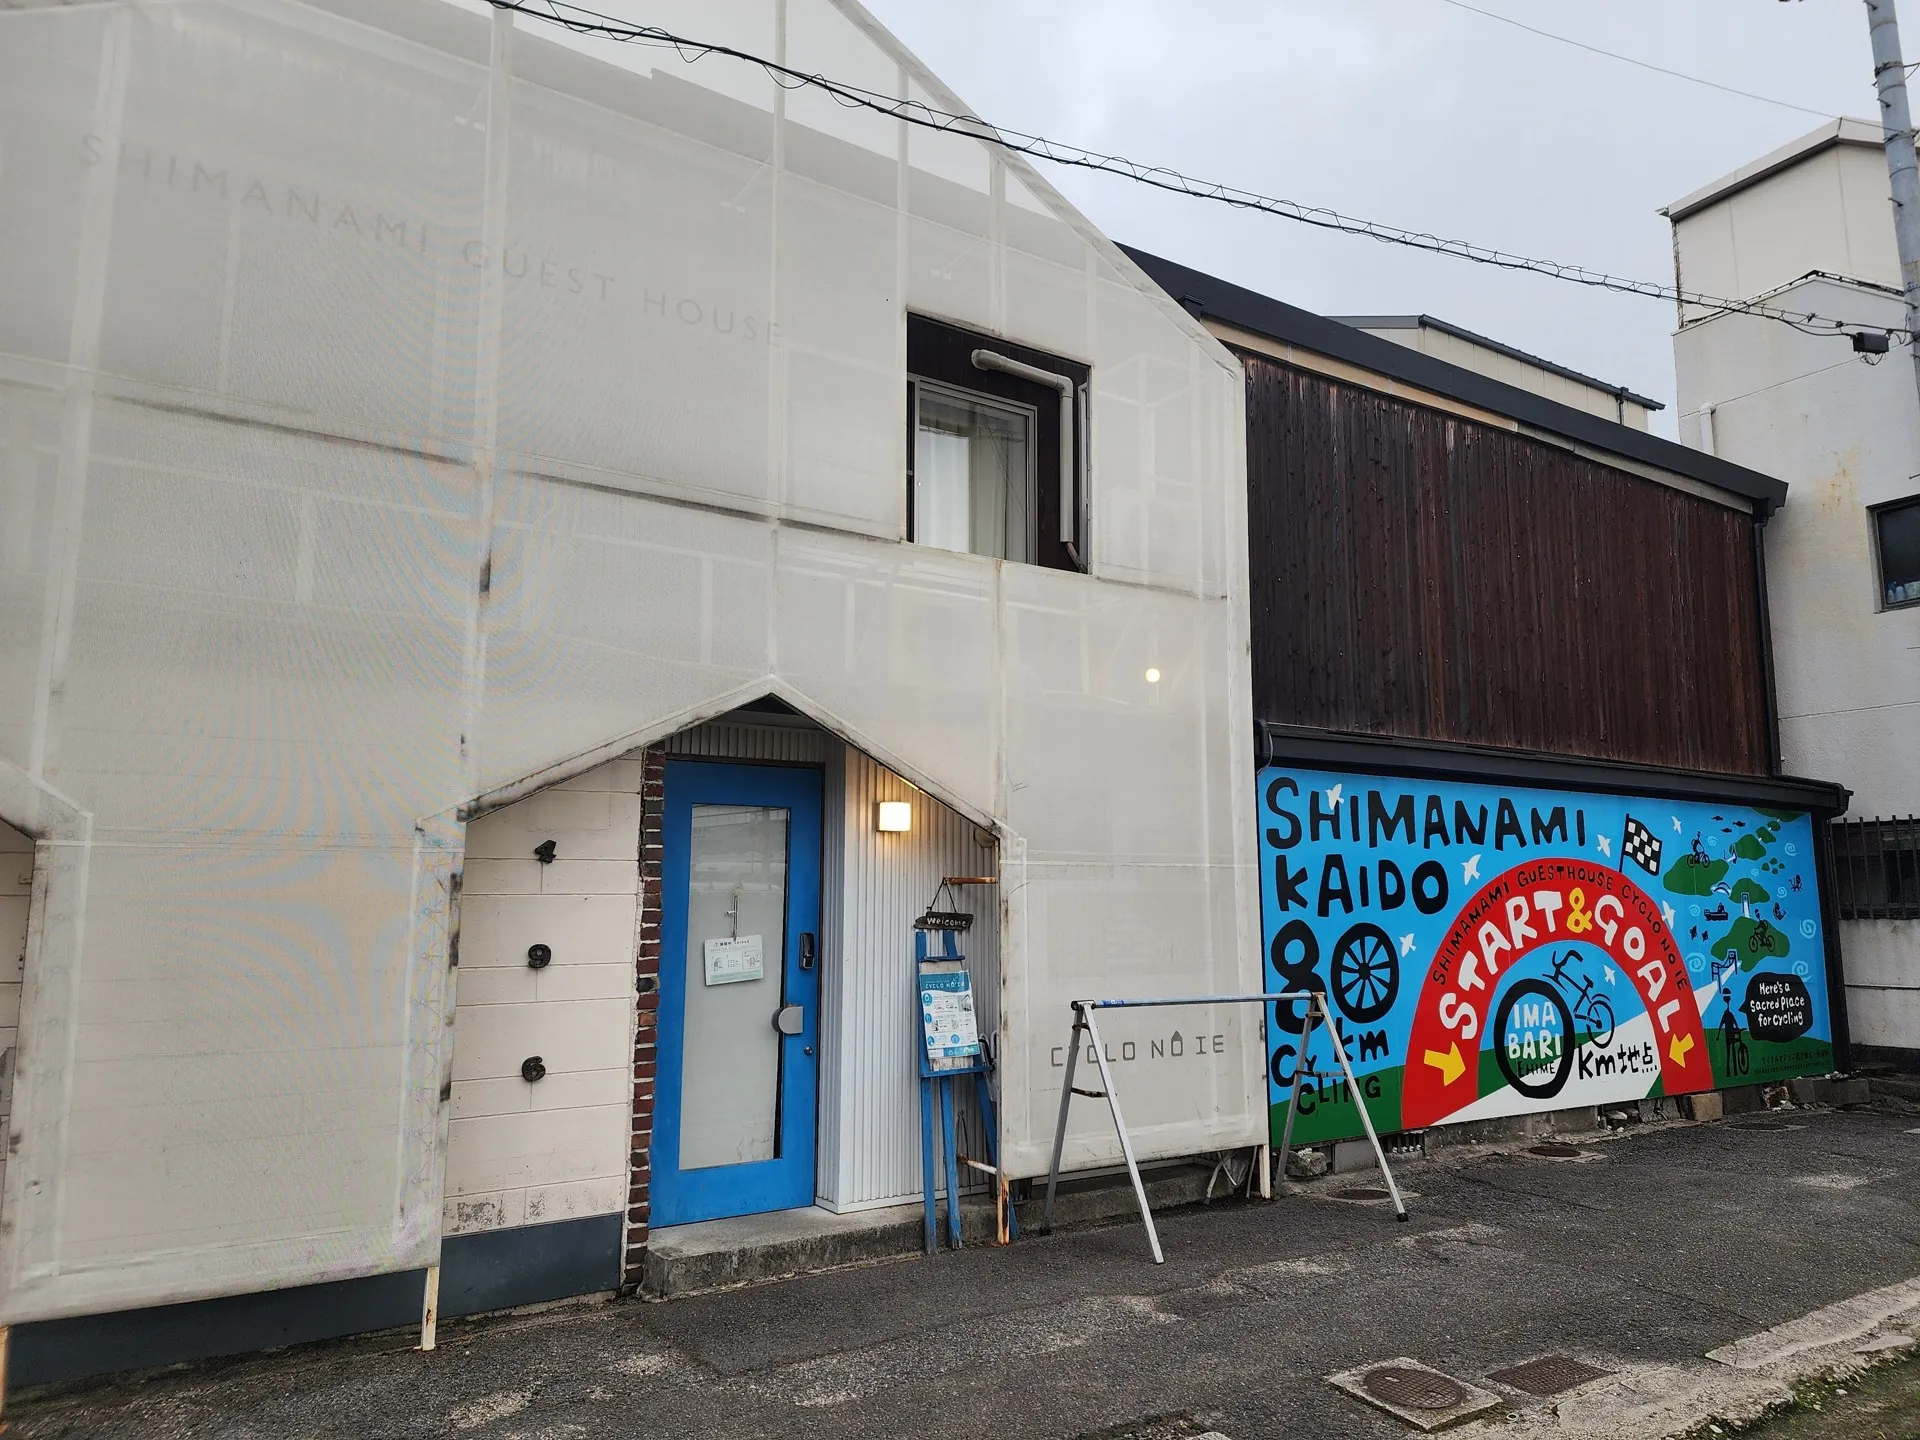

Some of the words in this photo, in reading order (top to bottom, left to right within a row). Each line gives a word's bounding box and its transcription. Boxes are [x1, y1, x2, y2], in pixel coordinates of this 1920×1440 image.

[79, 133, 428, 254] SHIMANAMI
[463, 240, 616, 302] GUEST
[642, 288, 782, 346] HOUSE
[1265, 776, 1586, 851] SHIMANAMI
[1275, 854, 1449, 918] KAIDO
[1439, 890, 1563, 1040] START
[1566, 887, 1593, 934] &
[1594, 894, 1681, 1034] GOAL
[1759, 981, 1784, 995] Here's
[1512, 1001, 1556, 1029] IMA
[1758, 1013, 1771, 1027] for
[1051, 1041, 1136, 1067] CCLO
[1195, 1034, 1224, 1056] IE
[1508, 1029, 1562, 1060] BARI
